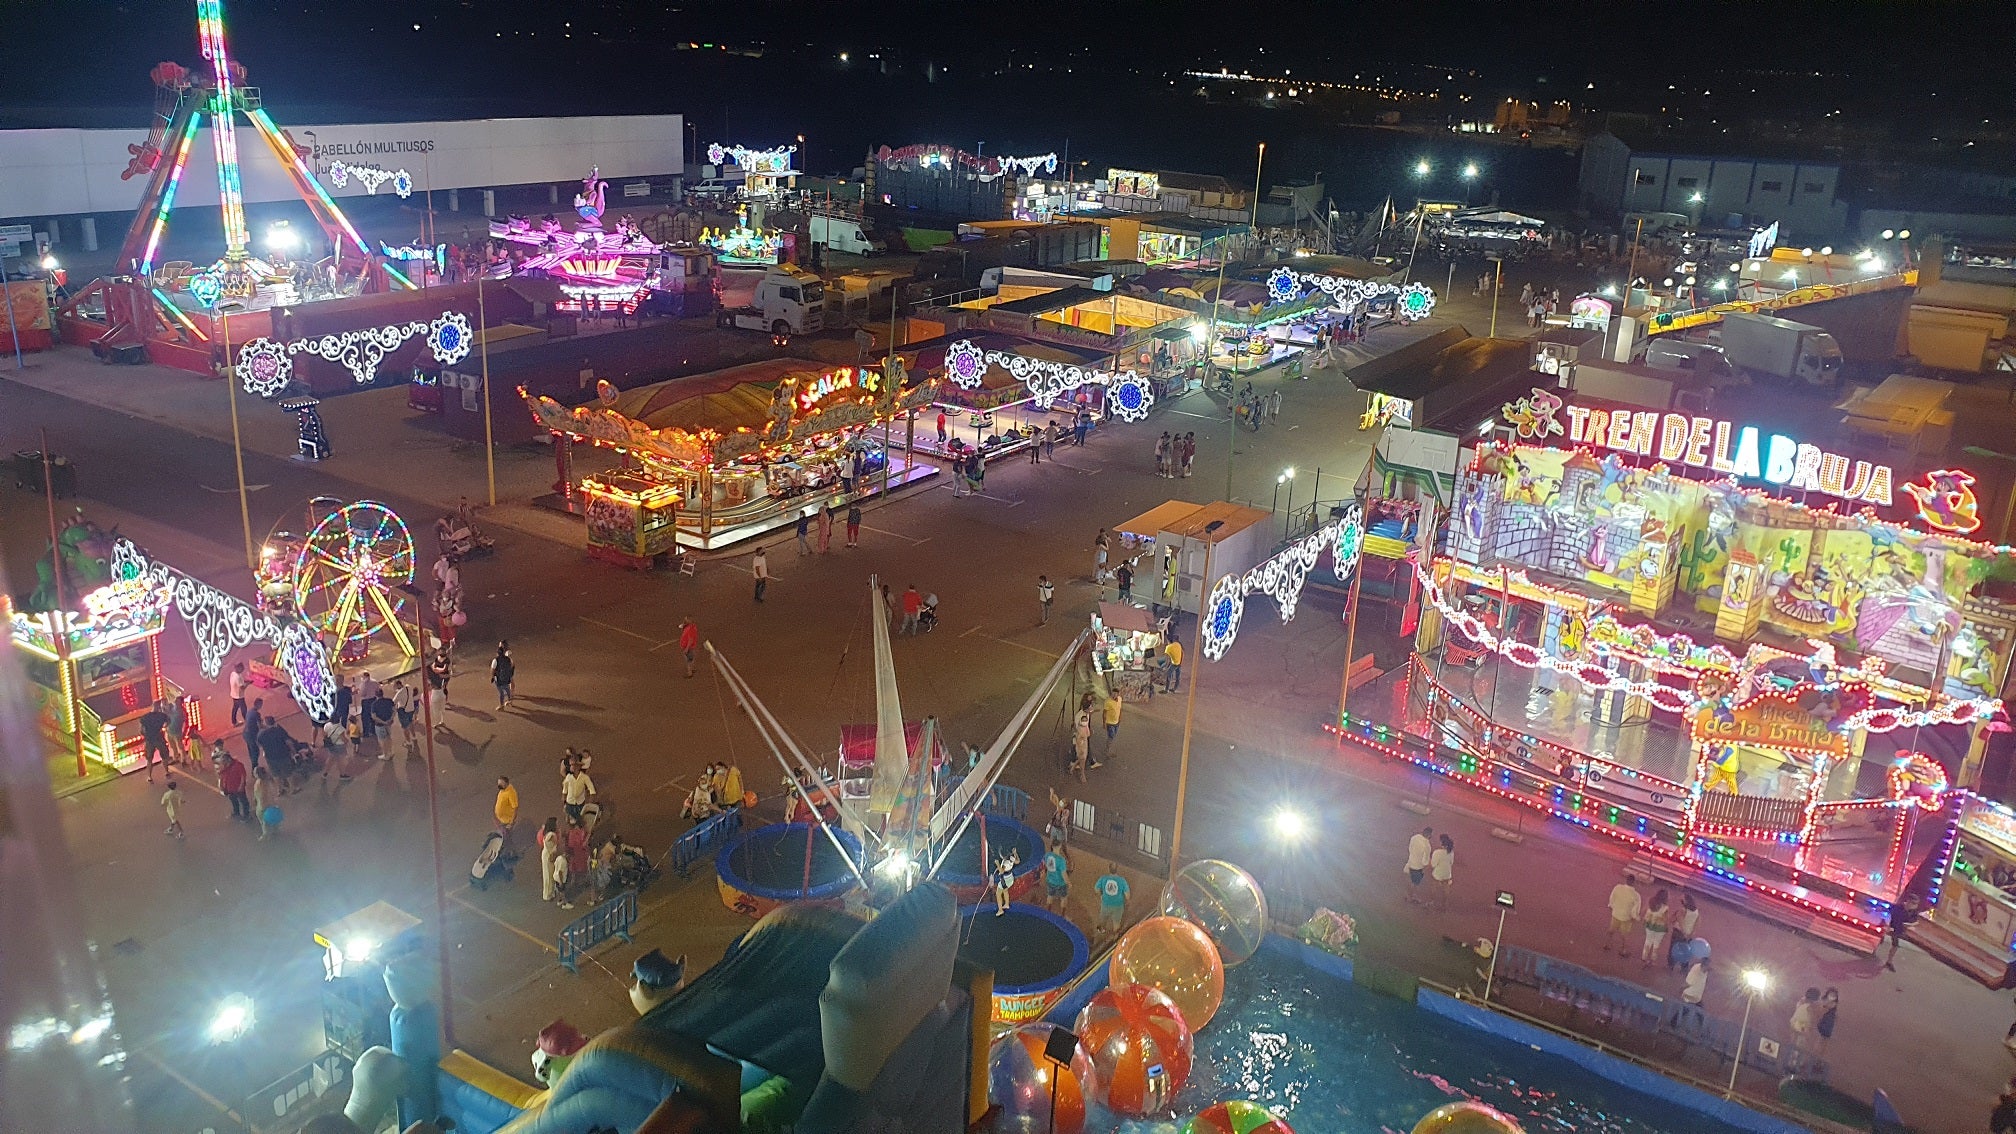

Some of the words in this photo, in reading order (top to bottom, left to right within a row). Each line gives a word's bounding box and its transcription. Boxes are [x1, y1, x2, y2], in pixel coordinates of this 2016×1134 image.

[314, 140, 372, 156] PABELLÓN
[374, 140, 434, 154] MULTIUSOS
[1566, 405, 1659, 455] TREN
[1659, 414, 1712, 467] DE
[1712, 421, 1760, 477] LA
[1766, 434, 1893, 506] BRUJA
[1704, 717, 1733, 734] de
[1739, 720, 1760, 737] la
[1000, 996, 1046, 1012] BUNGEE
